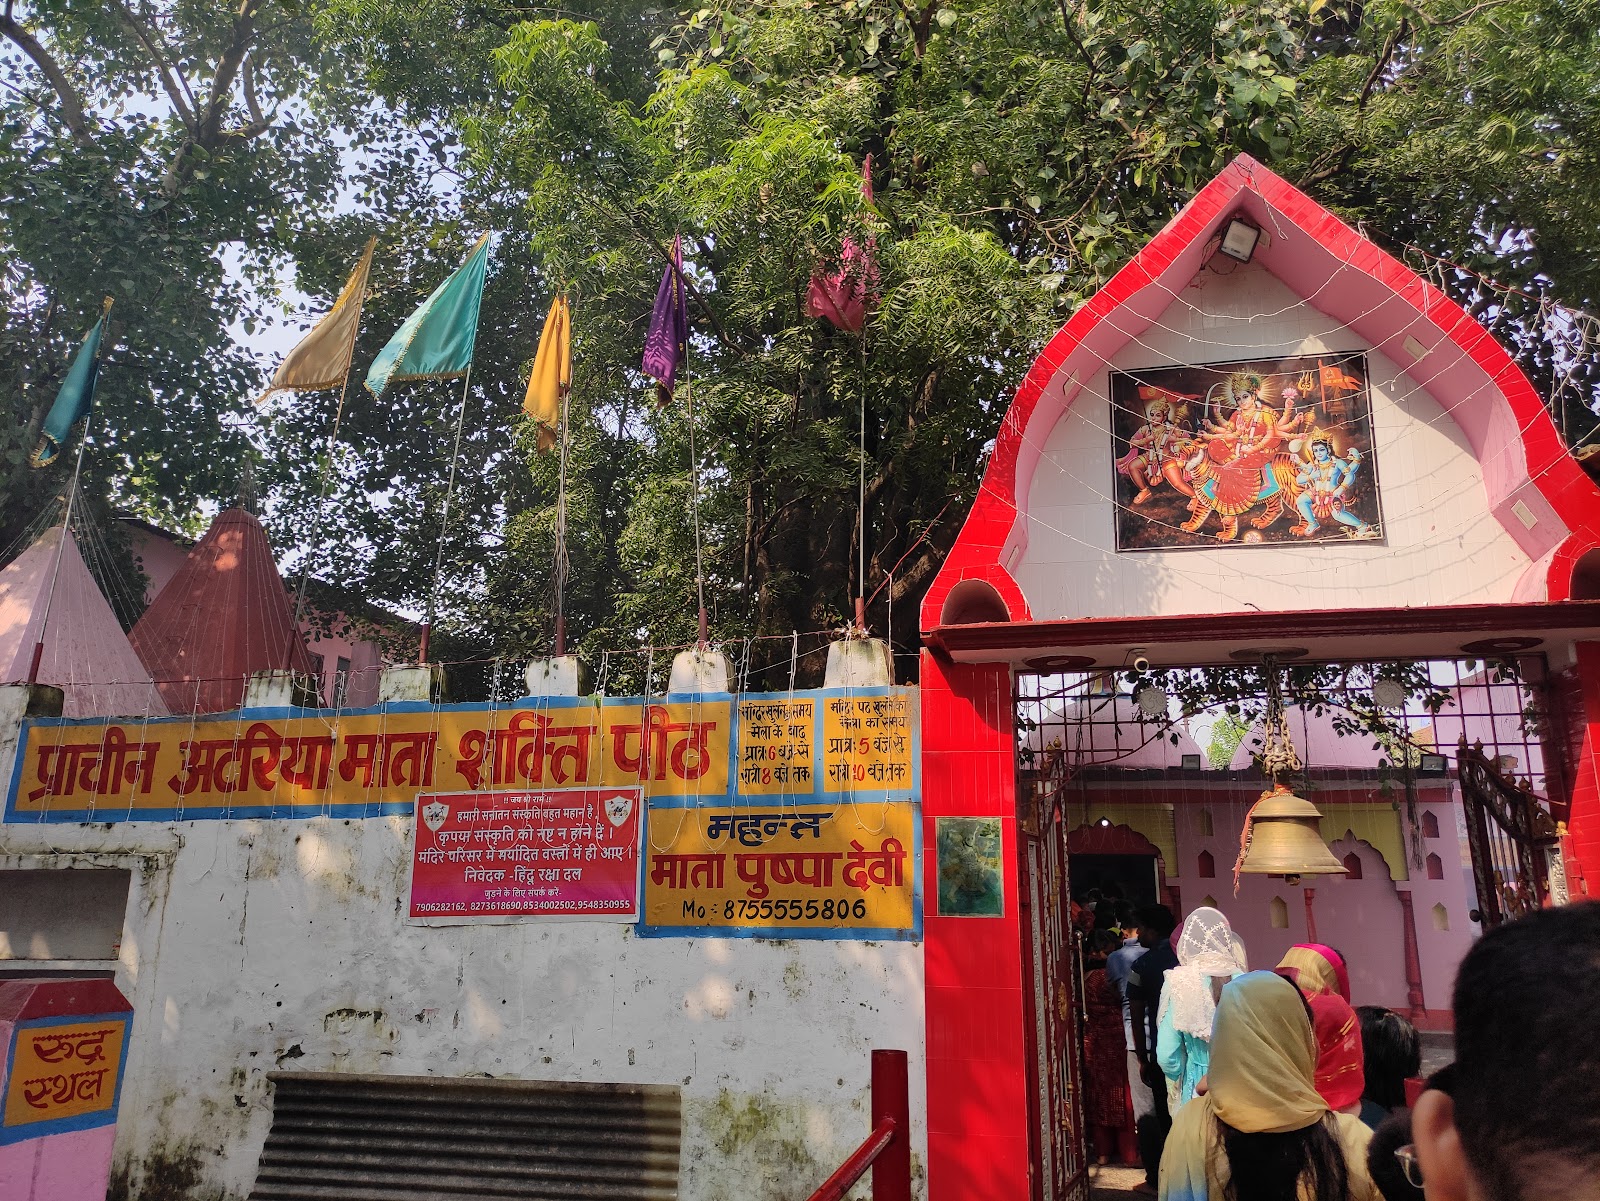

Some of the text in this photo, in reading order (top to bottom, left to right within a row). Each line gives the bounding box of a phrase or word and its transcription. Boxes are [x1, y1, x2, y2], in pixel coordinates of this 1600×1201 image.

[865, 717, 880, 728] का
[28, 706, 716, 802] प्राचीन अटरिया माता शक्ति पीठ
[768, 745, 776, 760] 6
[796, 741, 810, 760] से
[859, 738, 870, 755] 5
[761, 768, 771, 785] 8
[792, 766, 811, 784] तक
[852, 764, 865, 781] 10
[867, 760, 884, 782] बजे
[885, 763, 907, 783] तक
[456, 807, 480, 823] हमारी
[481, 809, 511, 821] सनातन
[512, 805, 541, 822] संस्कृति
[542, 808, 561, 822] बहुत
[563, 807, 585, 820] महान
[438, 830, 472, 847] कृपया
[473, 825, 515, 846] संस्कृति
[517, 824, 535, 840] को
[557, 828, 567, 840] न
[570, 823, 592, 842] होने
[707, 812, 834, 847] महन्त
[418, 847, 445, 865] मंदिर
[447, 846, 483, 864] परिसर
[485, 846, 496, 862] में
[497, 844, 539, 862] मर्यादित
[571, 843, 583, 860] में
[584, 844, 598, 861] ही
[600, 846, 624, 861] आए
[464, 865, 506, 883] निवेदक
[537, 868, 560, 882] रक्षा
[562, 868, 583, 882] दल
[650, 838, 907, 899] माता पुष्पा देवी
[484, 887, 502, 900] जुड़ने
[503, 887, 511, 898] के
[512, 887, 526, 898] लिए
[527, 886, 547, 897] संपर्क
[416, 902, 467, 912] 7906282162,
[723, 898, 866, 920] 8755555806
[32, 1029, 117, 1066] रुद्र
[22, 1068, 111, 1109] स्थल
